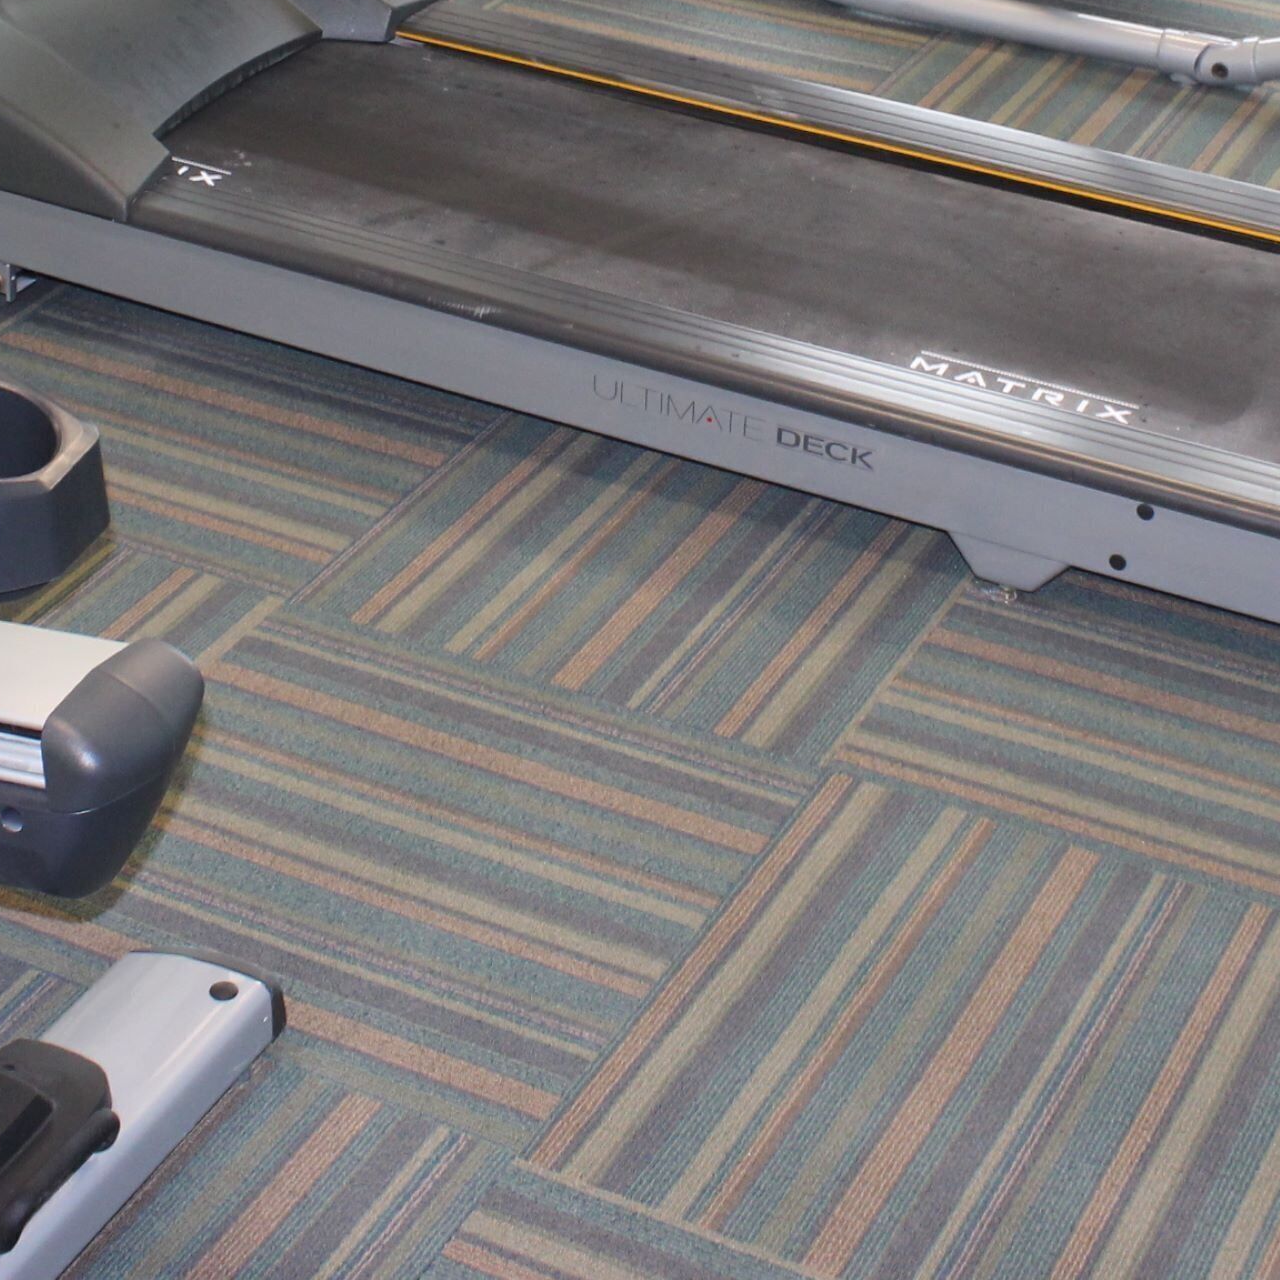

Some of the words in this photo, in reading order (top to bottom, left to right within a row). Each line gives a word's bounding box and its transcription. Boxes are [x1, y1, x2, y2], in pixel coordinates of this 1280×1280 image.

[593, 374, 766, 442] ULTIMATE
[776, 426, 874, 470] DECK
[910, 355, 1140, 425] MATRIX
